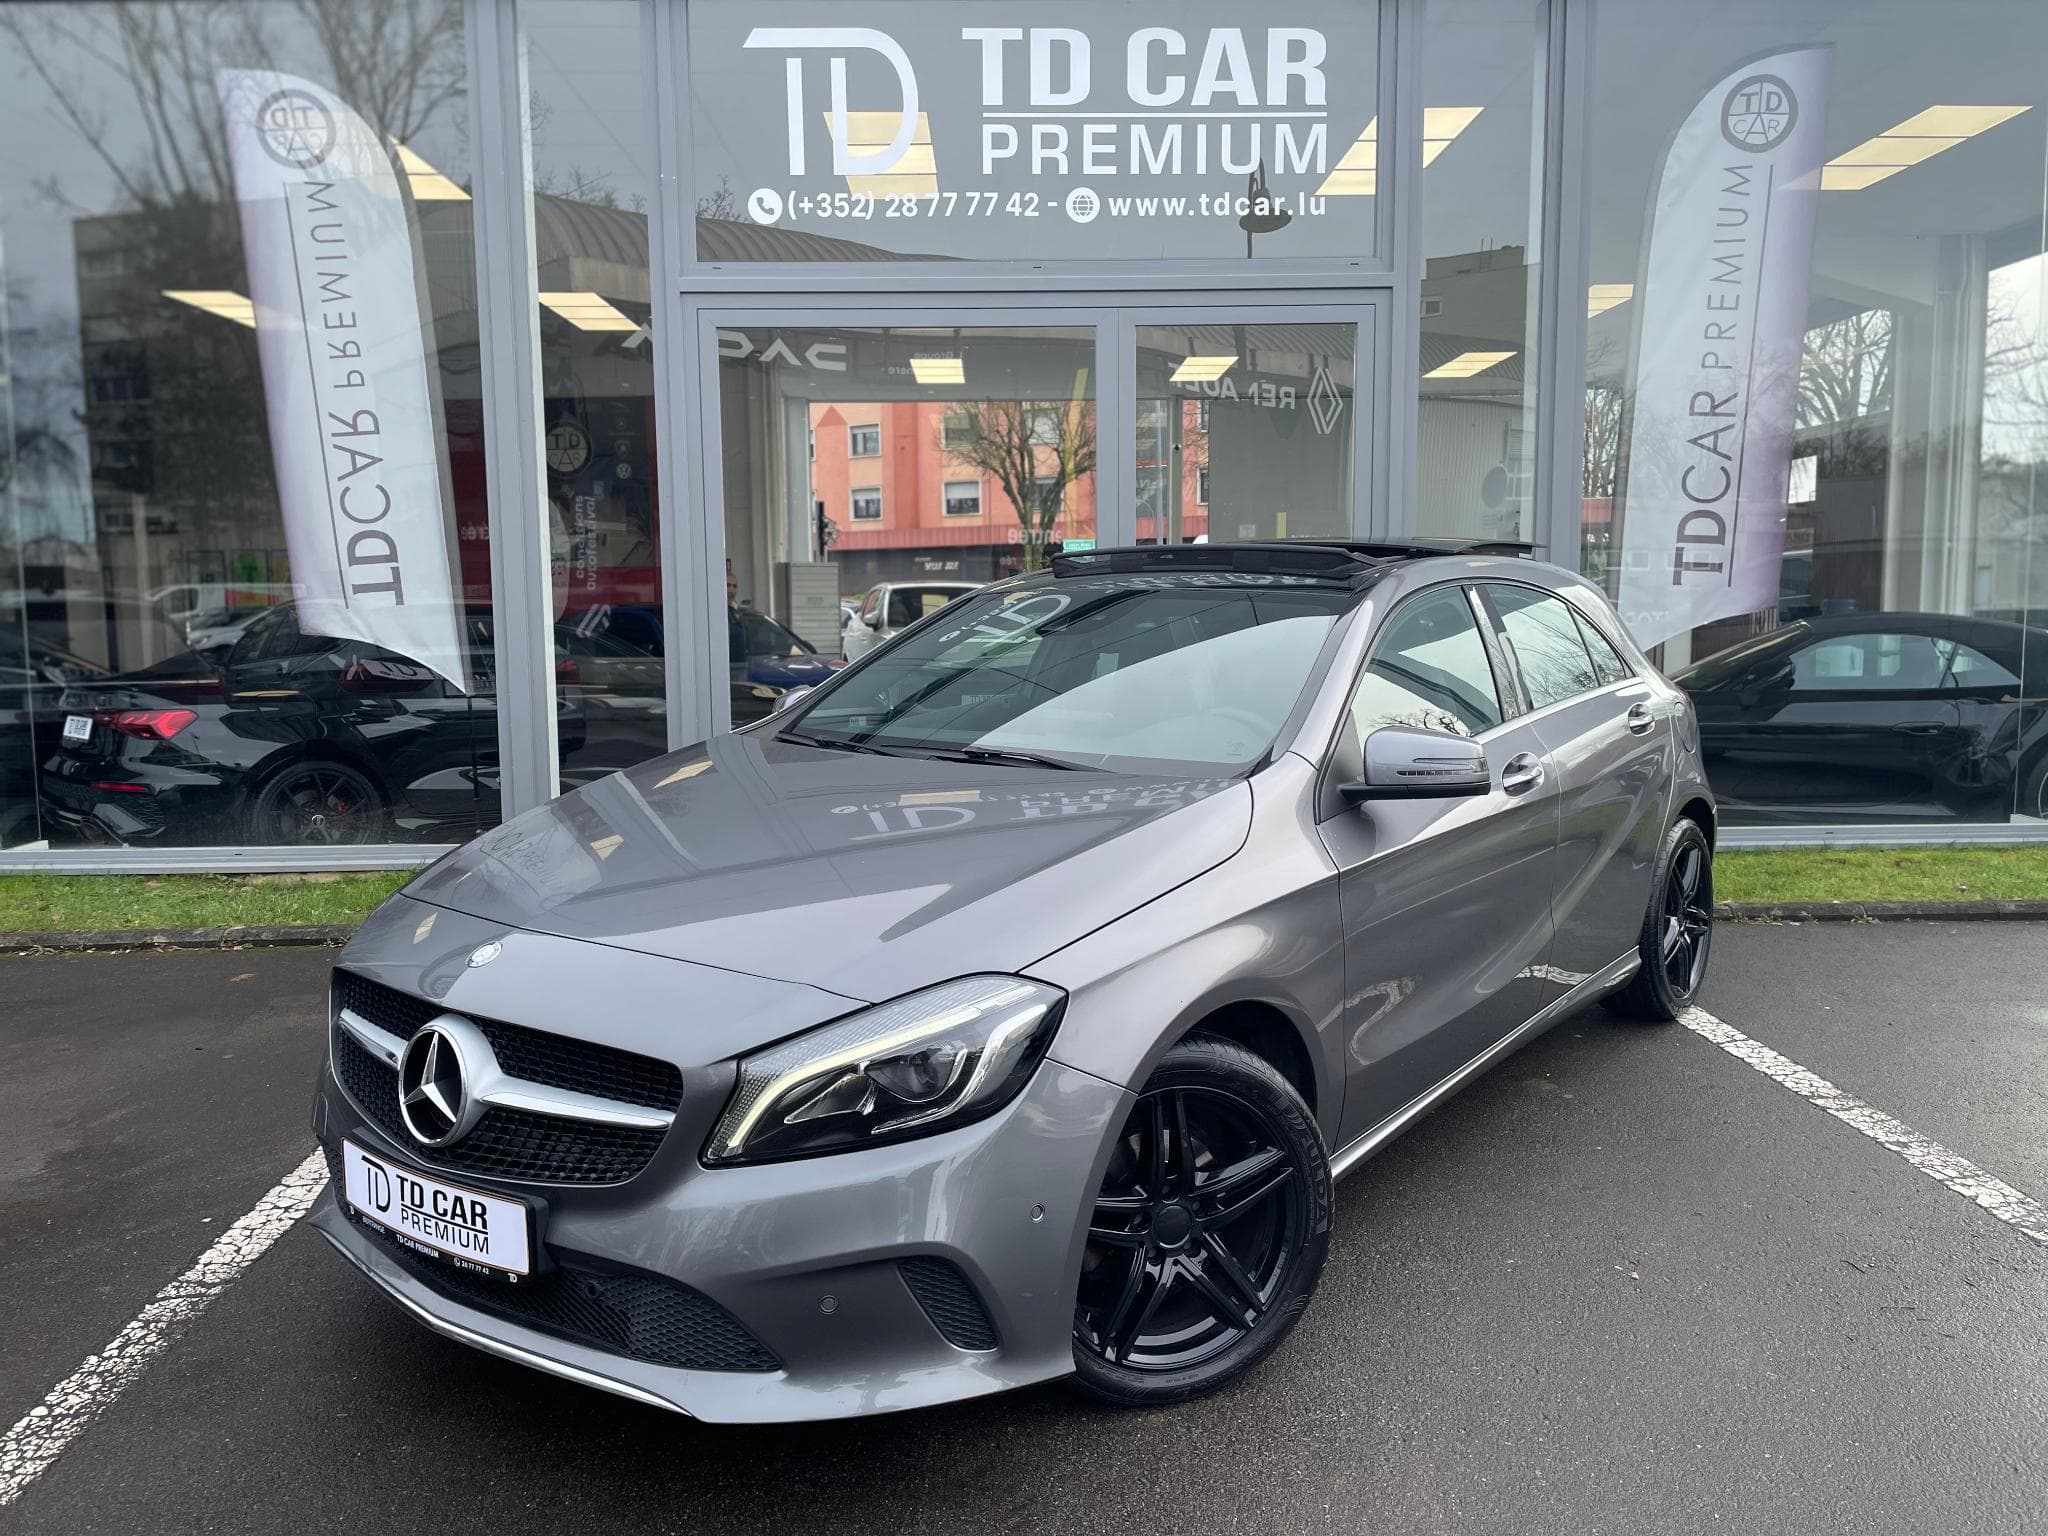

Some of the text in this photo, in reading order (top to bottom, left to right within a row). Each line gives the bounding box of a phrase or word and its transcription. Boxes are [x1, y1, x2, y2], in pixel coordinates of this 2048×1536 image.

[962, 26, 1327, 107] TD CAR
[1740, 91, 1782, 112] TD
[982, 123, 1327, 175] PREMIUM
[788, 188, 875, 221] (+352)
[885, 192, 918, 217] 28
[926, 192, 960, 217] 77
[965, 192, 999, 217] 77
[1004, 192, 1040, 217] 42
[1108, 191, 1327, 217] www.tdcar.lu
[1702, 165, 1753, 369] PREMIUM
[396, 1174, 425, 1209] TD
[432, 1189, 489, 1231] CAR
[401, 1208, 489, 1255] PREMIUM
